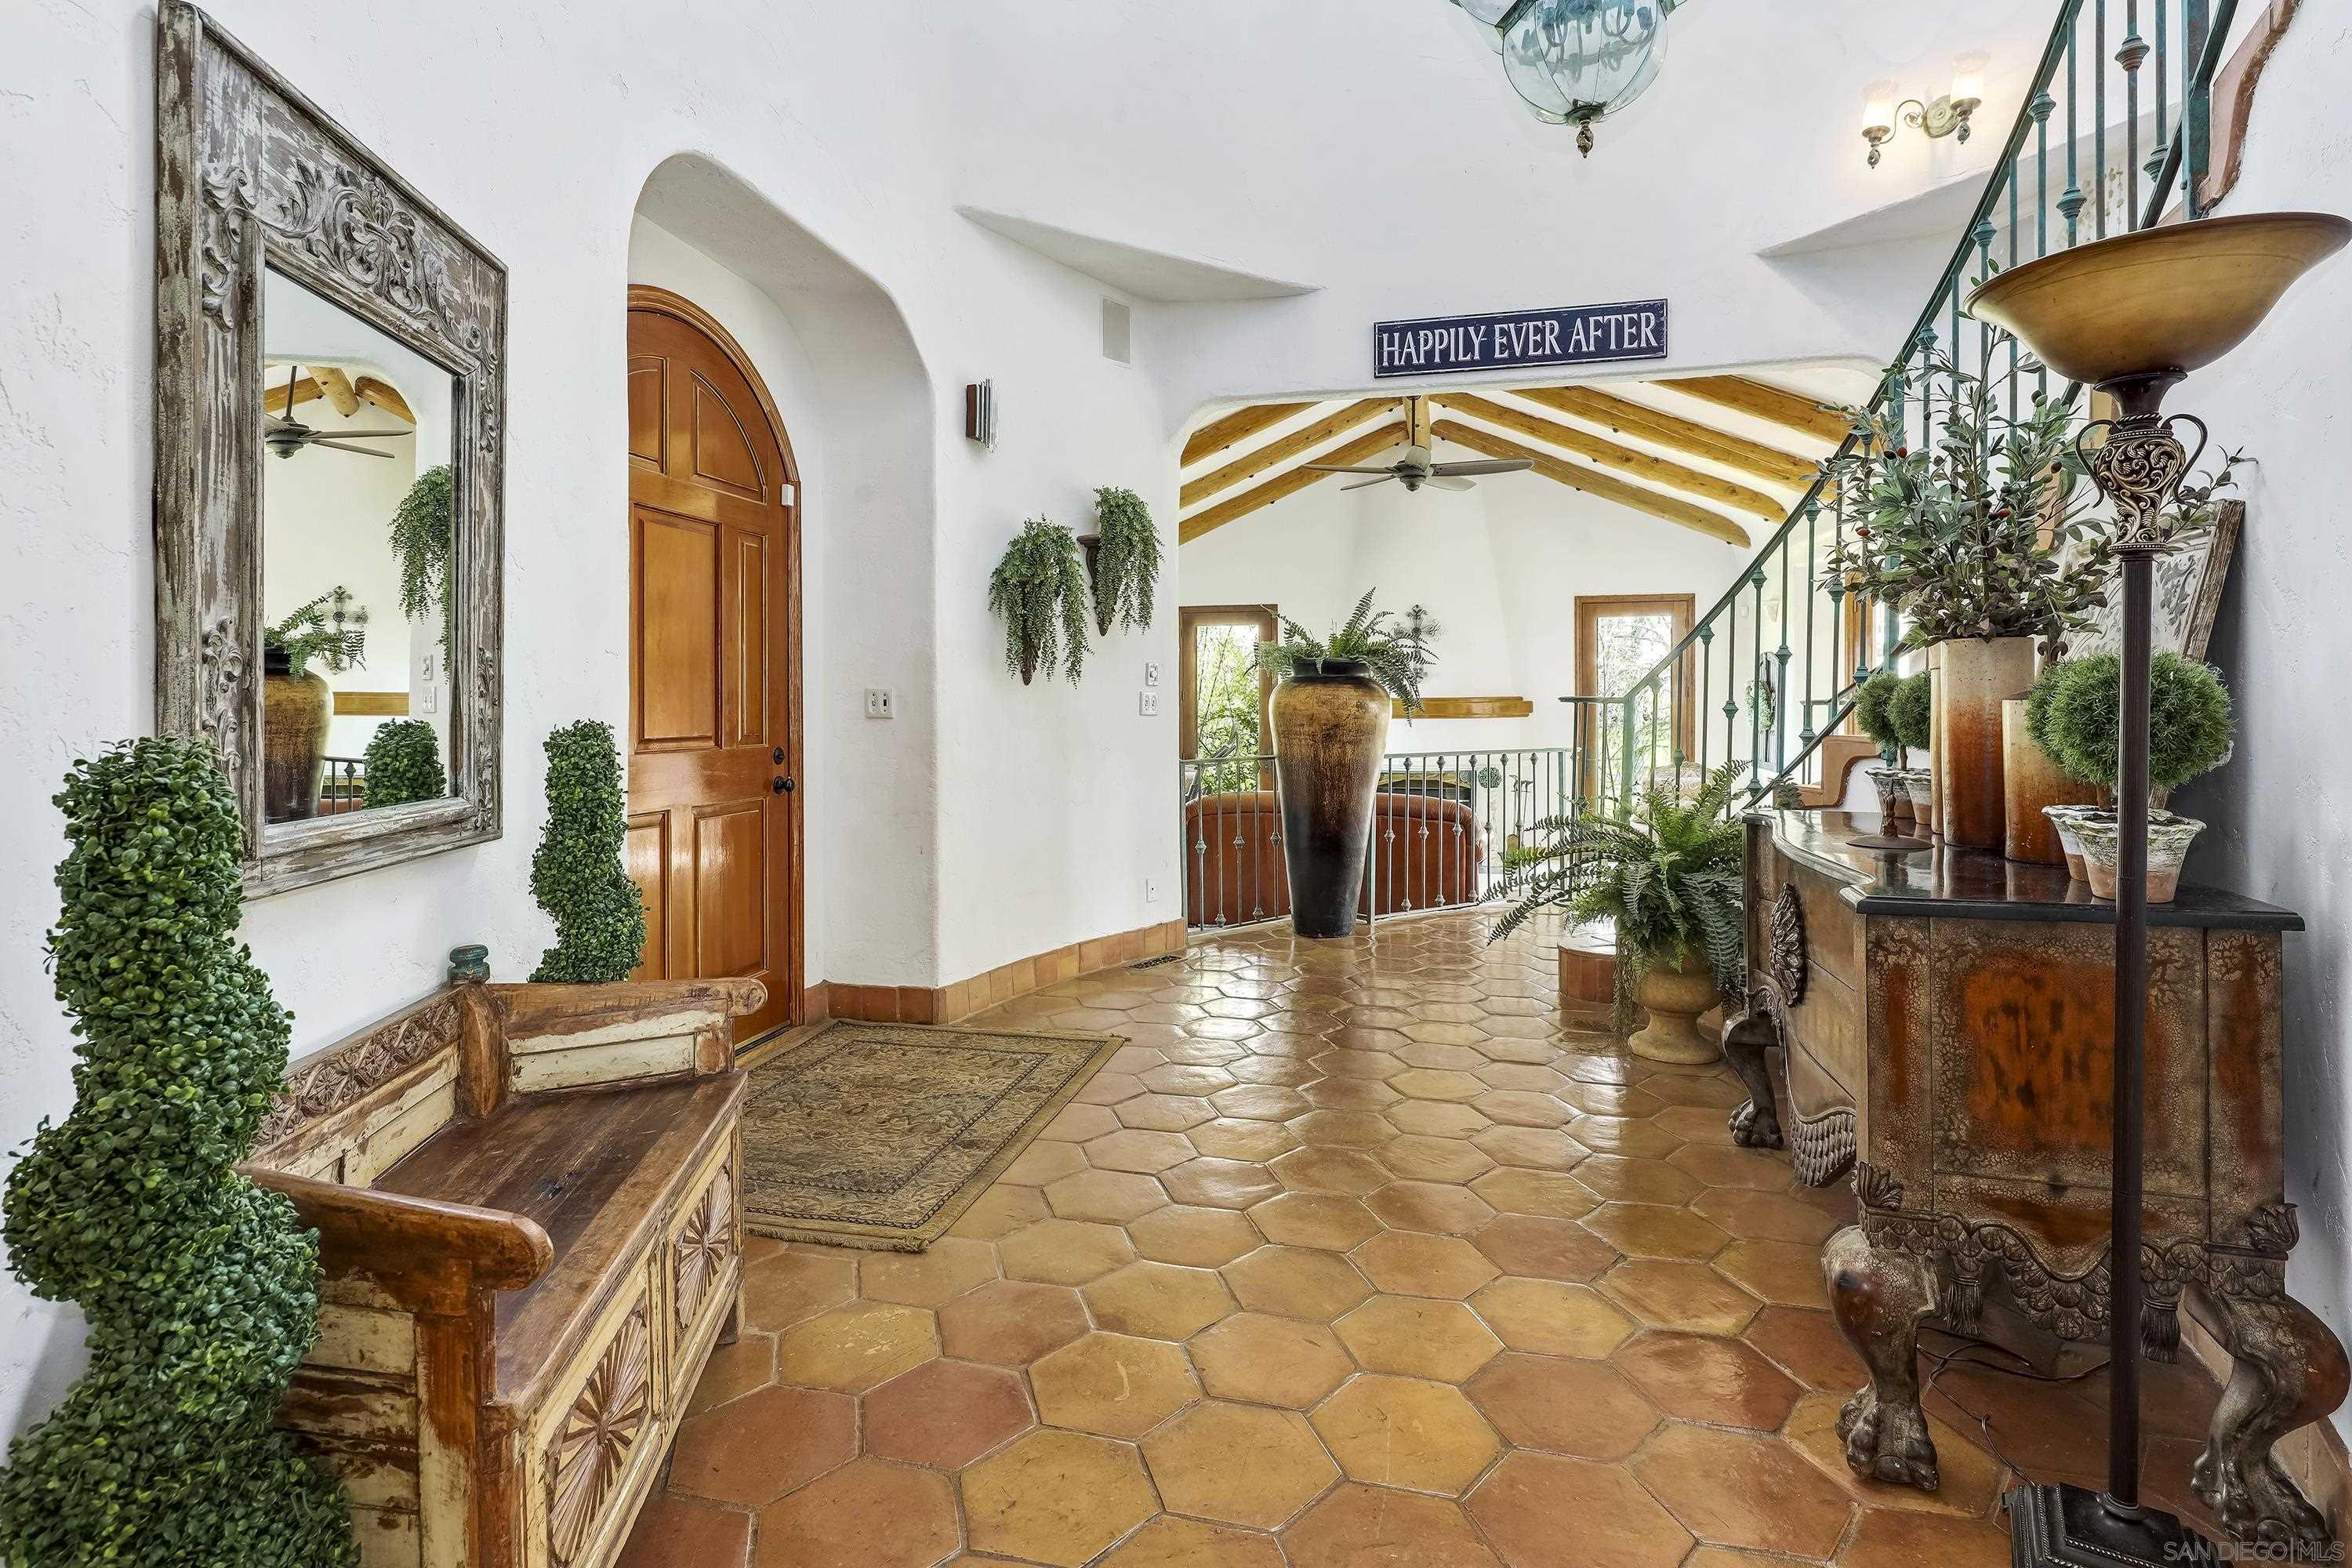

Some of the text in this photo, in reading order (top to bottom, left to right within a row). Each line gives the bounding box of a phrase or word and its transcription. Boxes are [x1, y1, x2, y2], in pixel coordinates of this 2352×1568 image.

[1382, 311, 1659, 367] HAPPILY EVER AFTER
